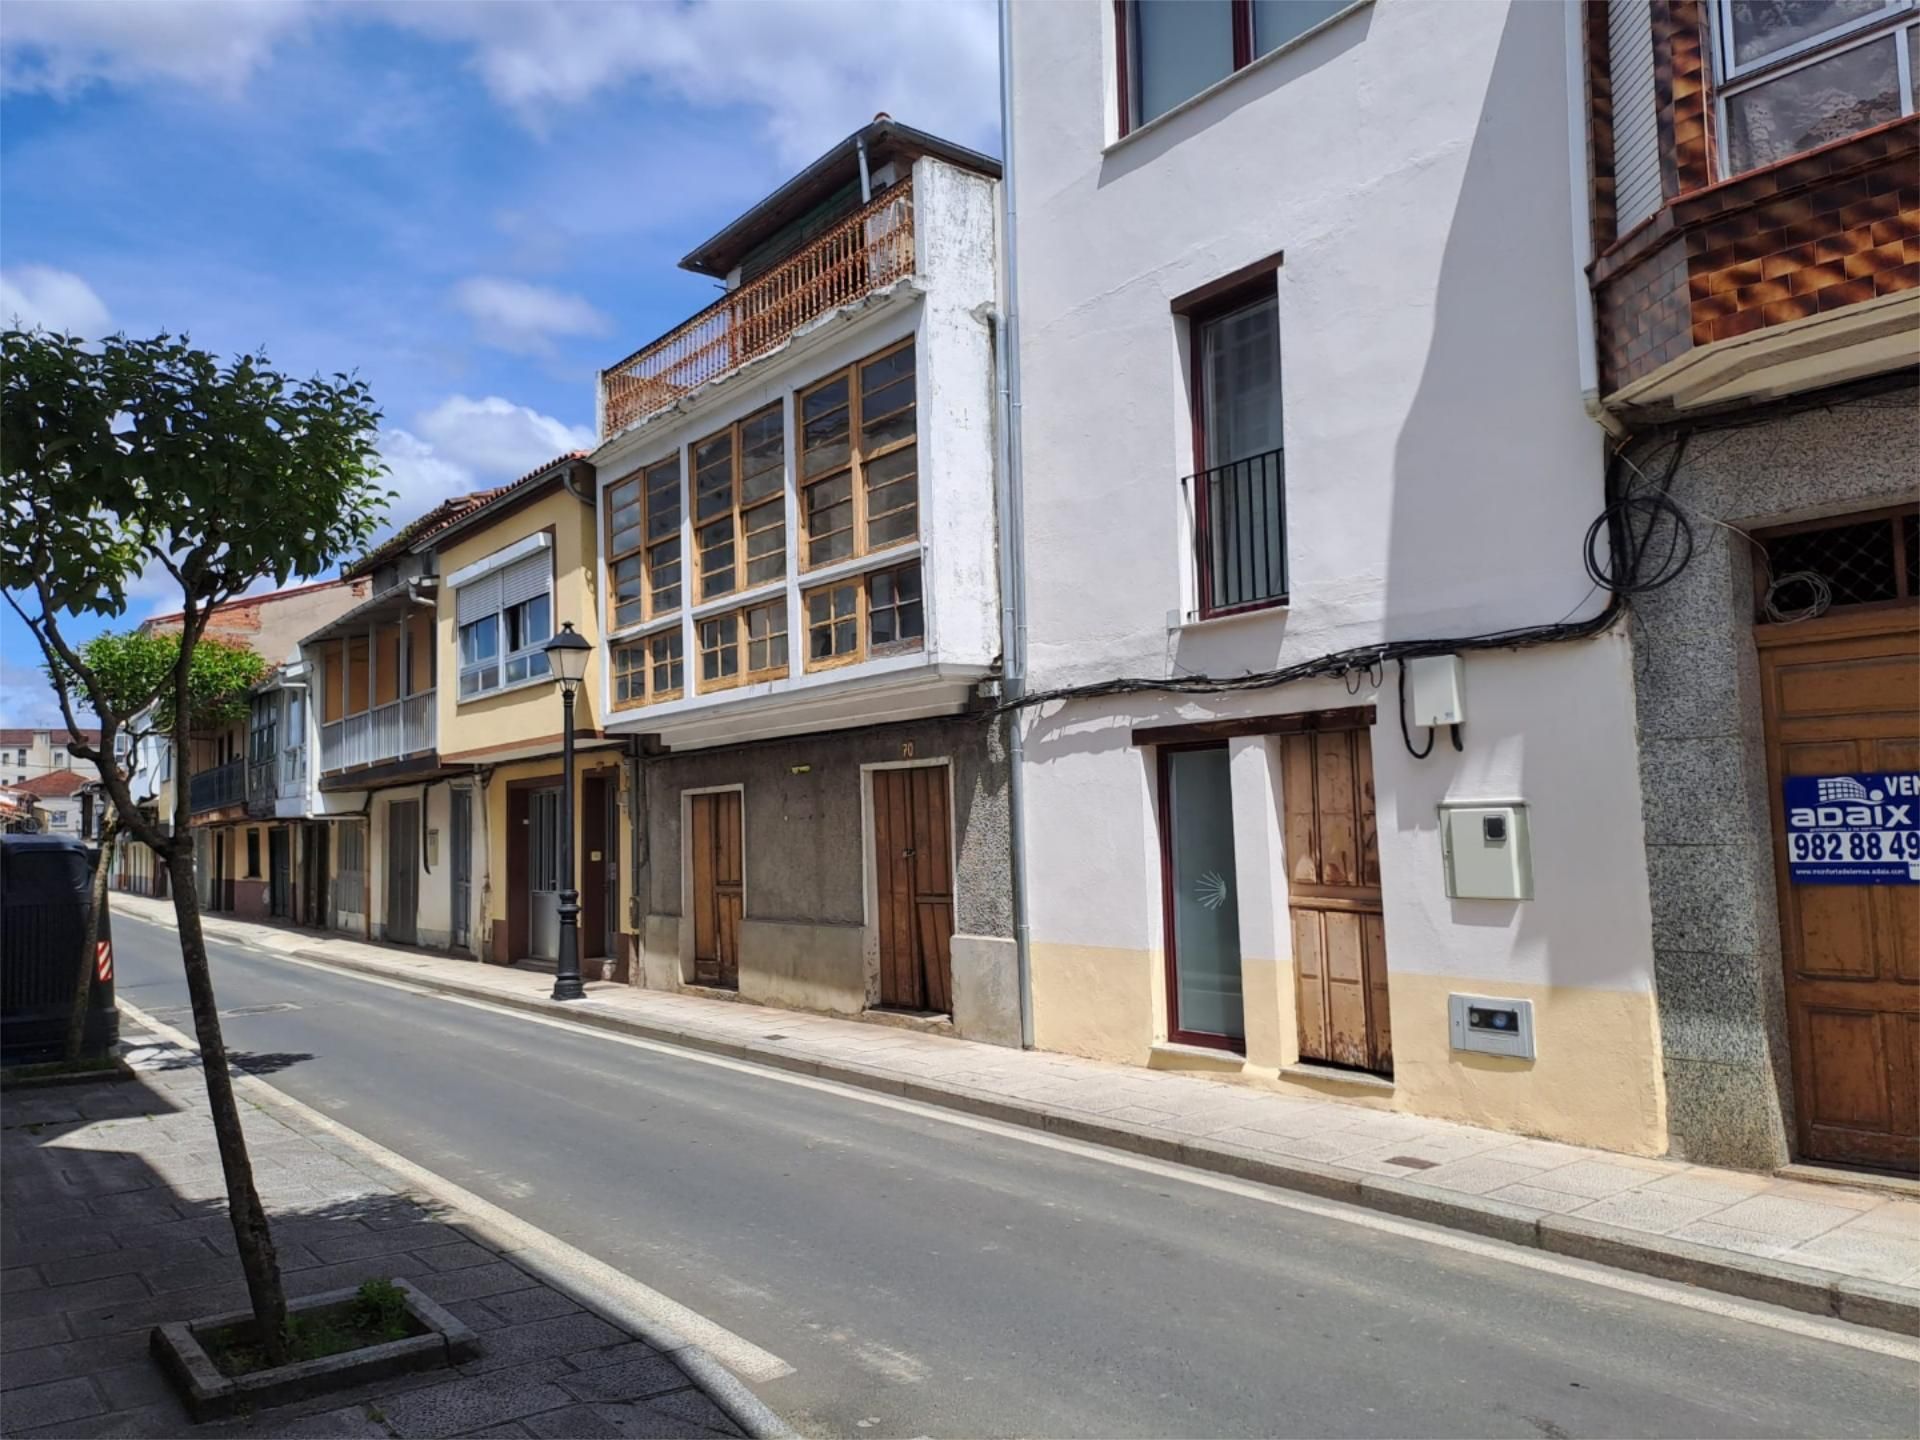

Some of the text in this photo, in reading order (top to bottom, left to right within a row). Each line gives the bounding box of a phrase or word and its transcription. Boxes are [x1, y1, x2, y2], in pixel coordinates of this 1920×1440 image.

[1794, 831, 1920, 861] 982 88 49
